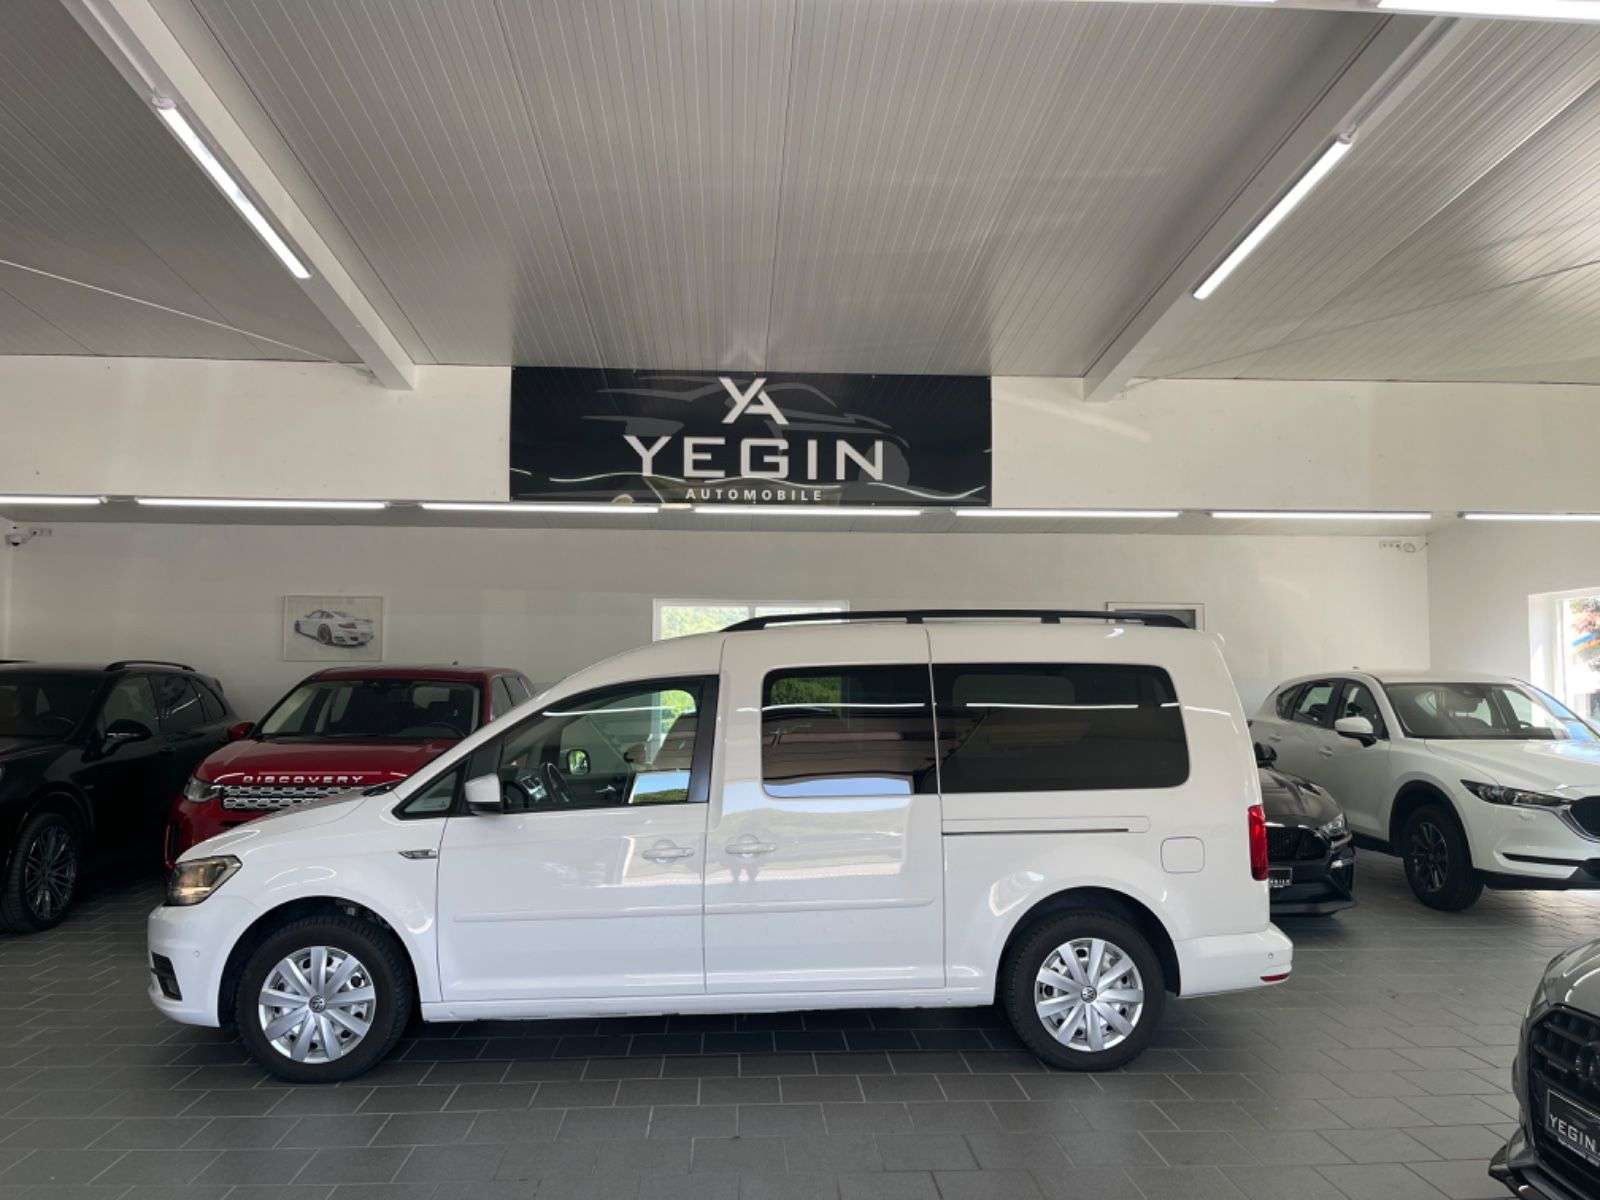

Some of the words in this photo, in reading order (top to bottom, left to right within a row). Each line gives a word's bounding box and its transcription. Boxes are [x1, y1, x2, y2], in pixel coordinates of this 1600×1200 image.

[623, 435, 884, 481] YEGIN
[685, 488, 822, 501] AUTOMOBILE
[242, 775, 363, 784] DISCOVERY
[1549, 1113, 1596, 1153] YEGIN
